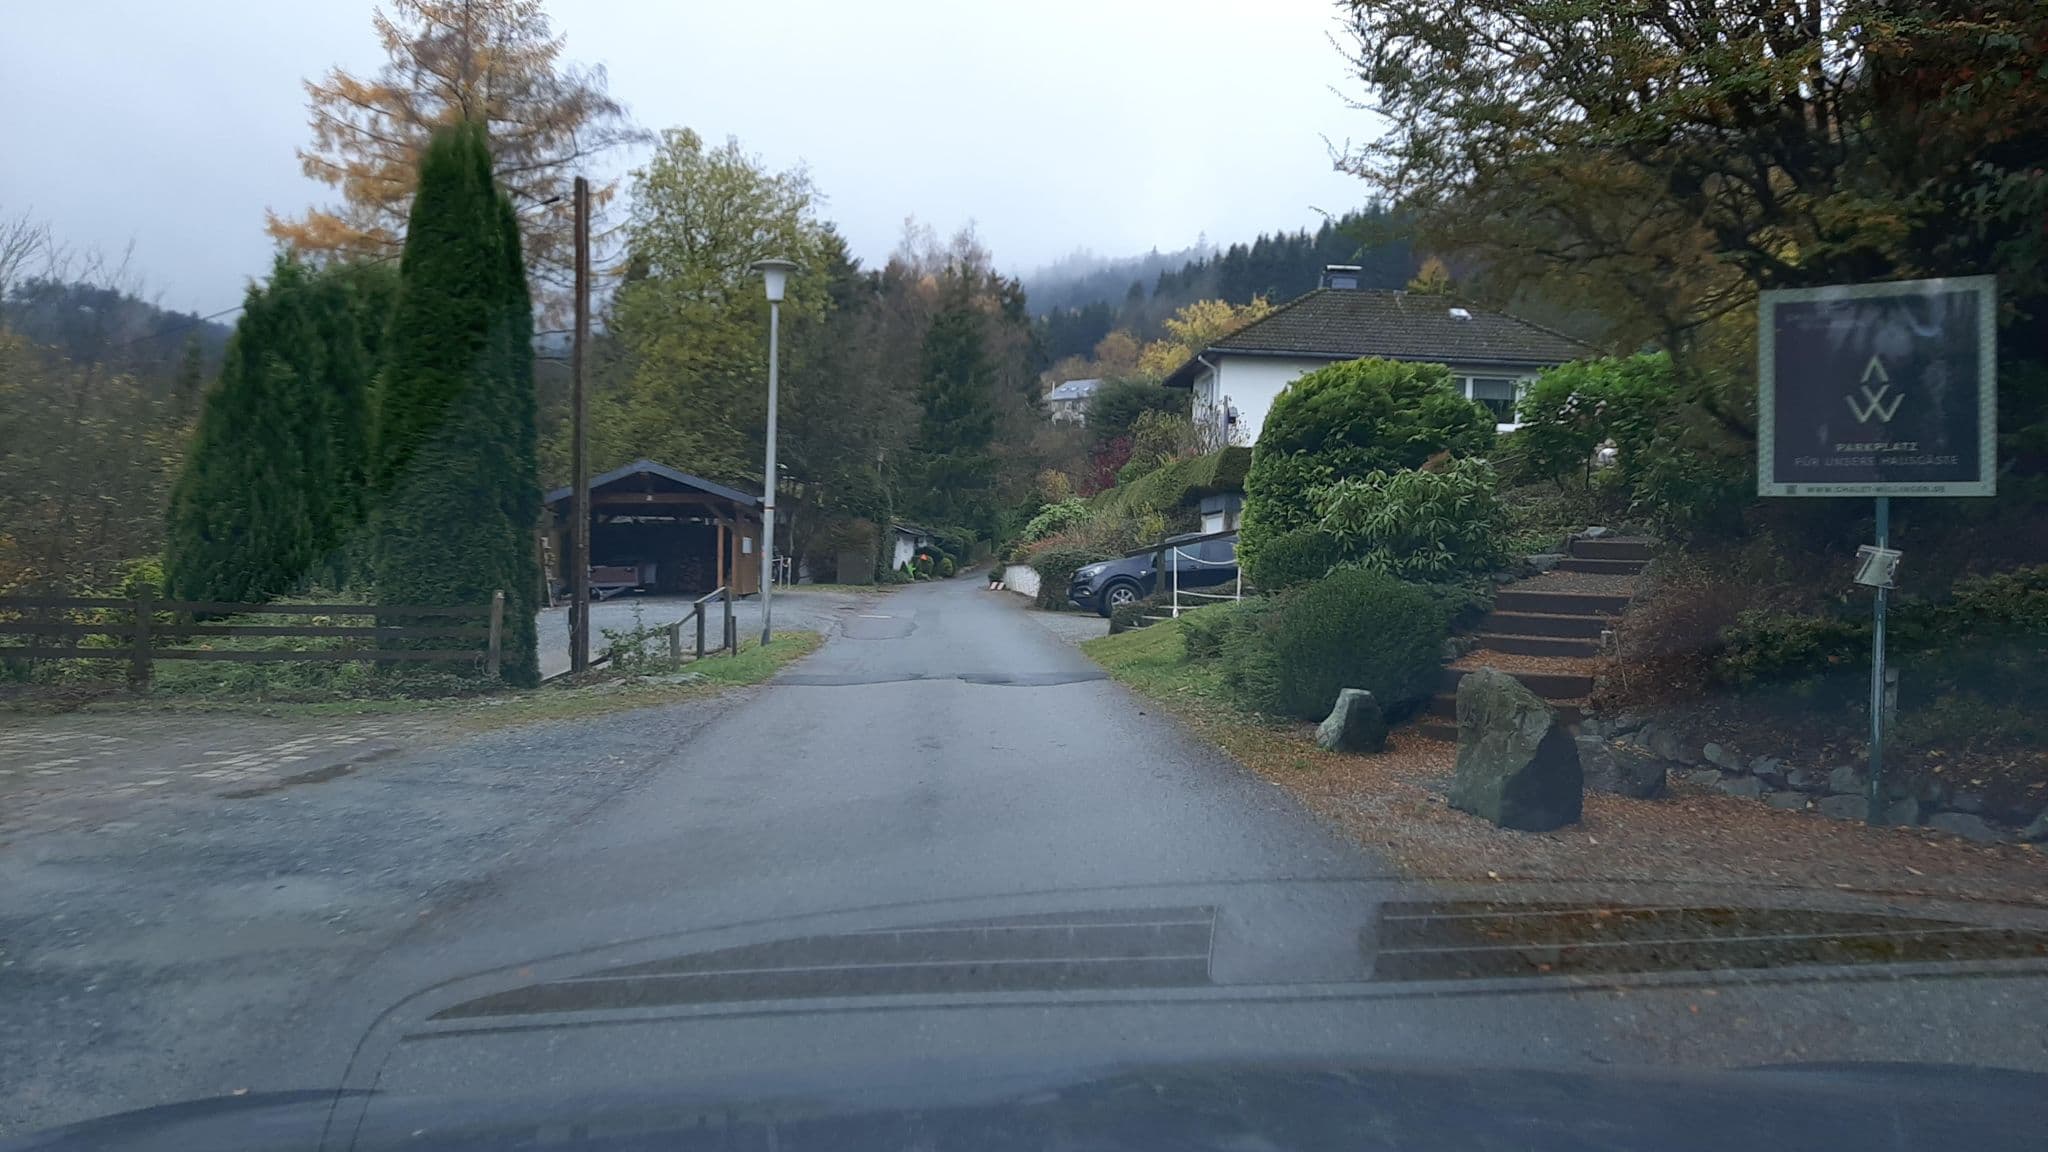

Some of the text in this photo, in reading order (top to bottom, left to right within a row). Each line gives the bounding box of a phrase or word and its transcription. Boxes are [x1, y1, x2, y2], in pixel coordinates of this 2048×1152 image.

[1835, 441, 1920, 452] PARKPLATZ
[1794, 455, 1819, 466] FÜR
[1824, 456, 1876, 466] UNSERE
